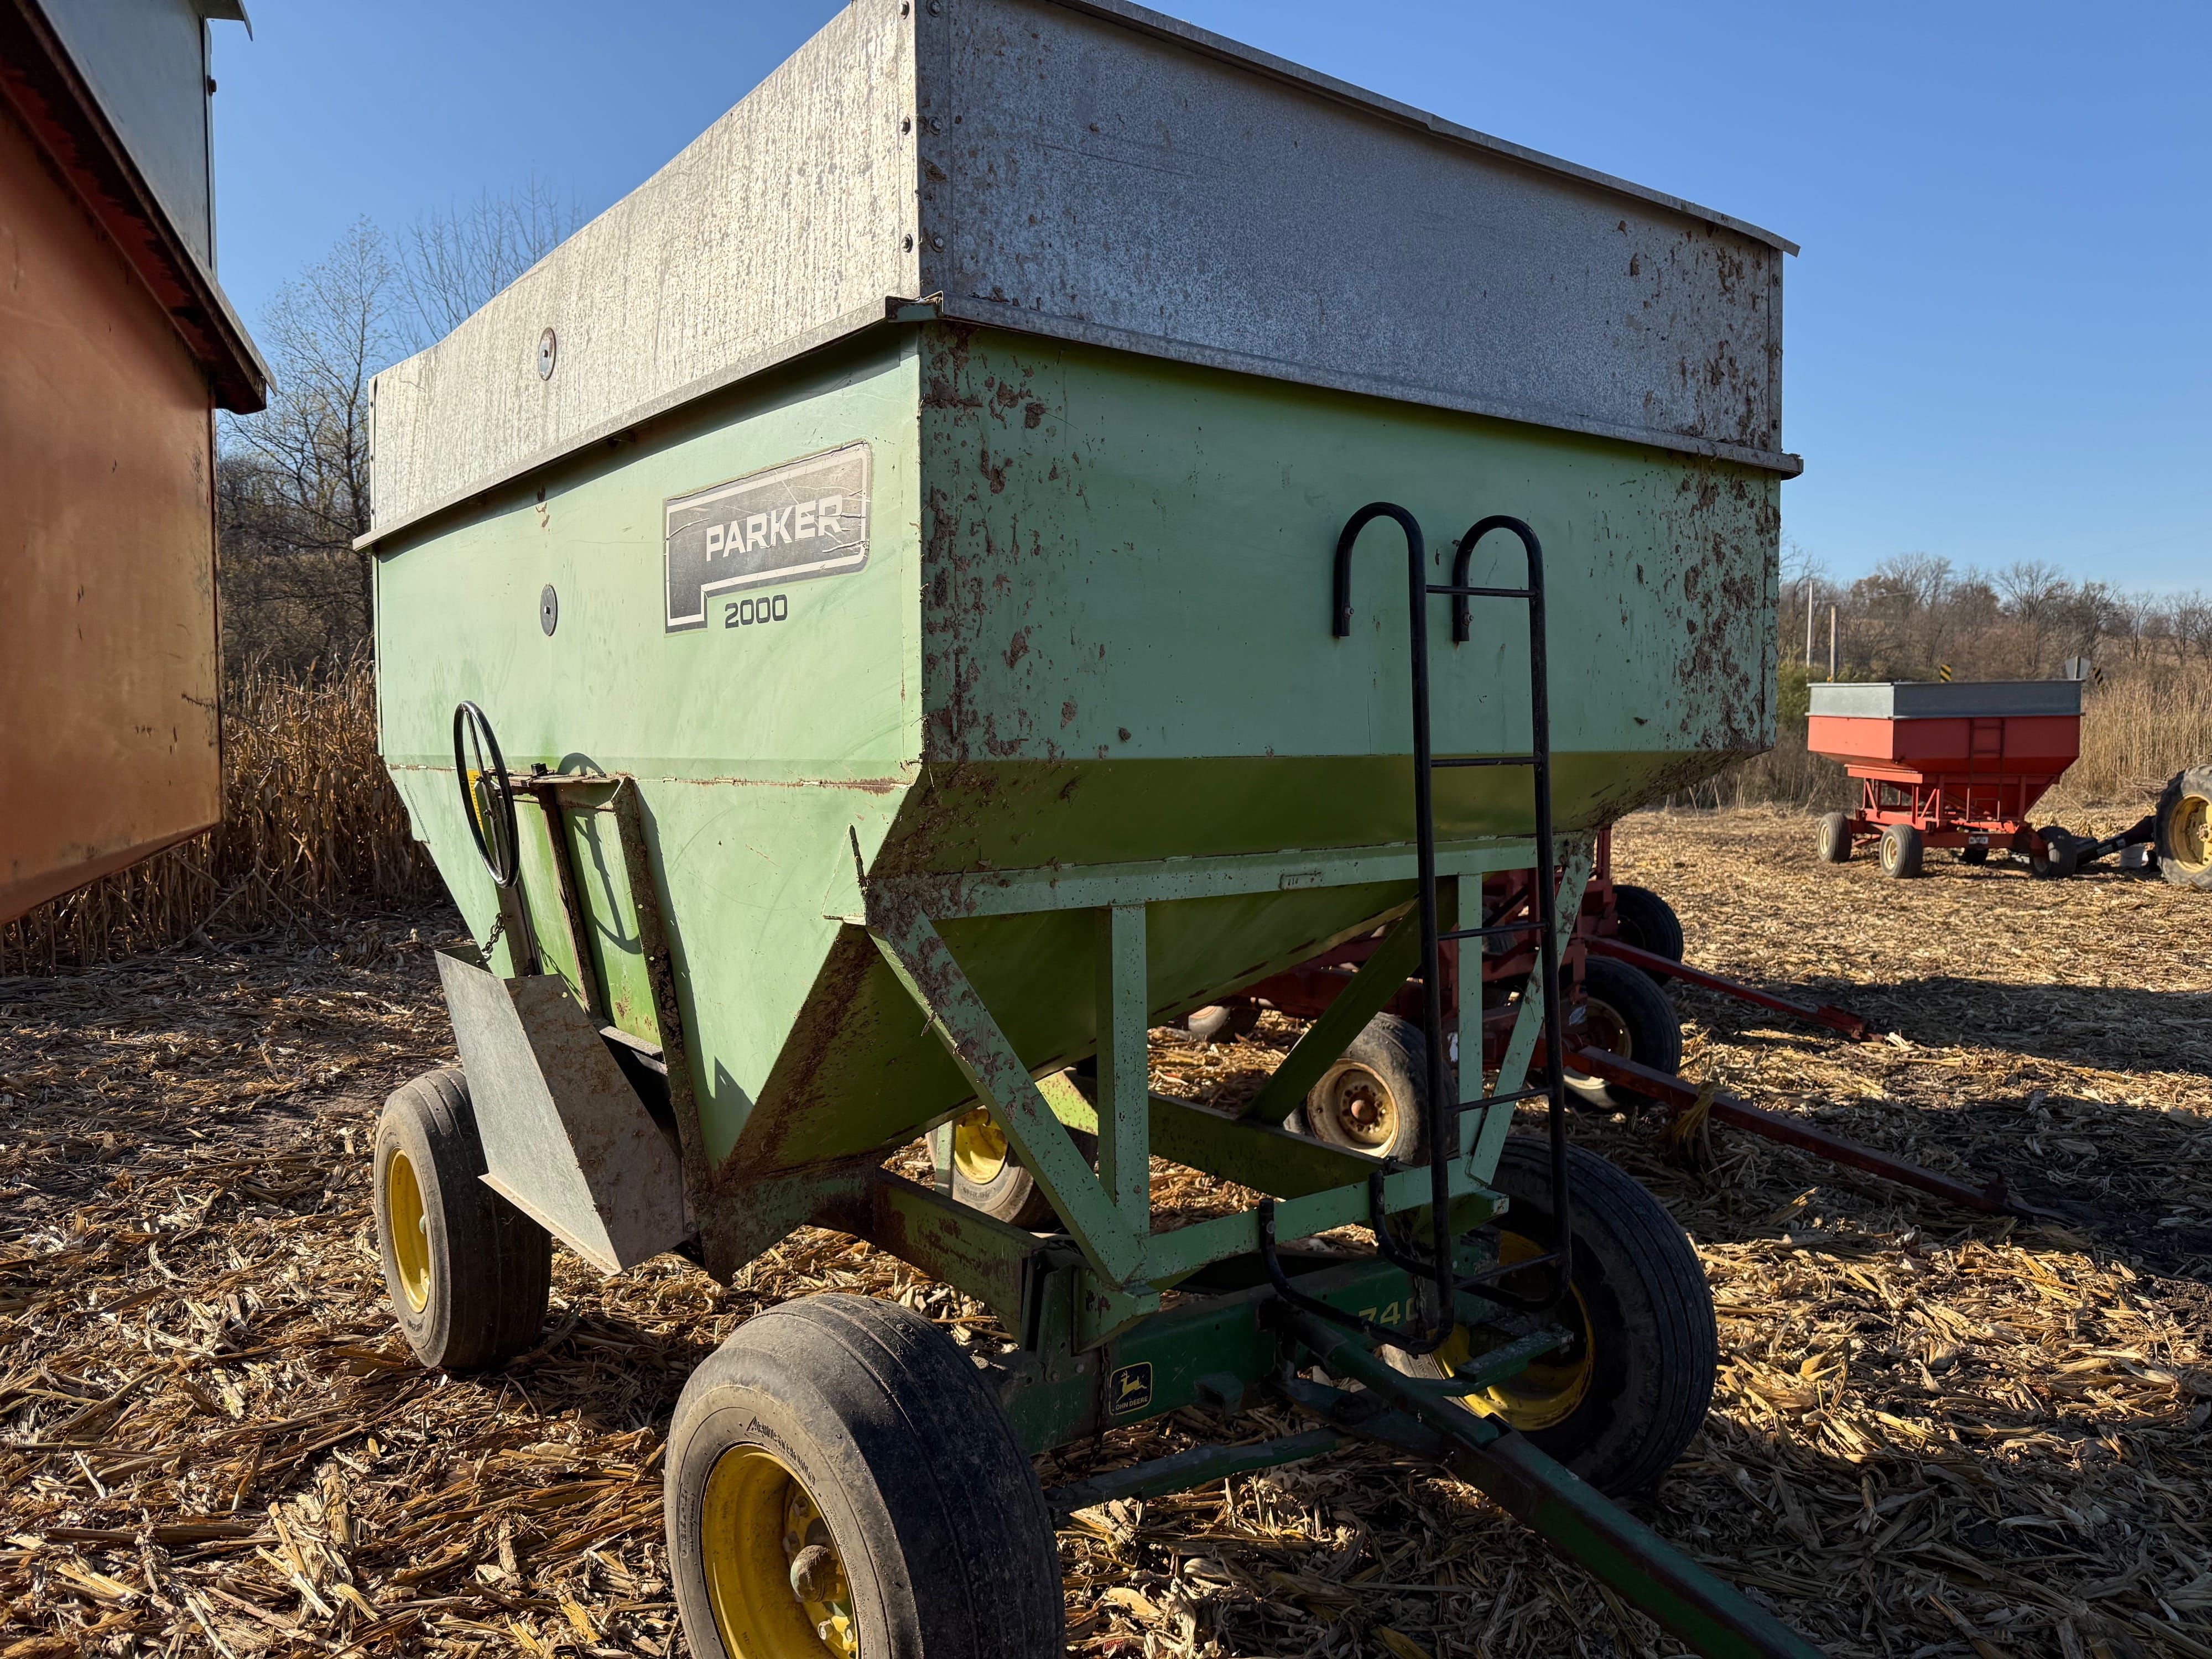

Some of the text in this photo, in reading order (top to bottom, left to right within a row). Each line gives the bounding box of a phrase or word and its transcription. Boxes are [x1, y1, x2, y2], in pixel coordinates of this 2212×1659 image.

[706, 494, 843, 562] PARKER
[725, 594, 788, 629] 2000
[1116, 1396, 1148, 1410] OHN DEERE
